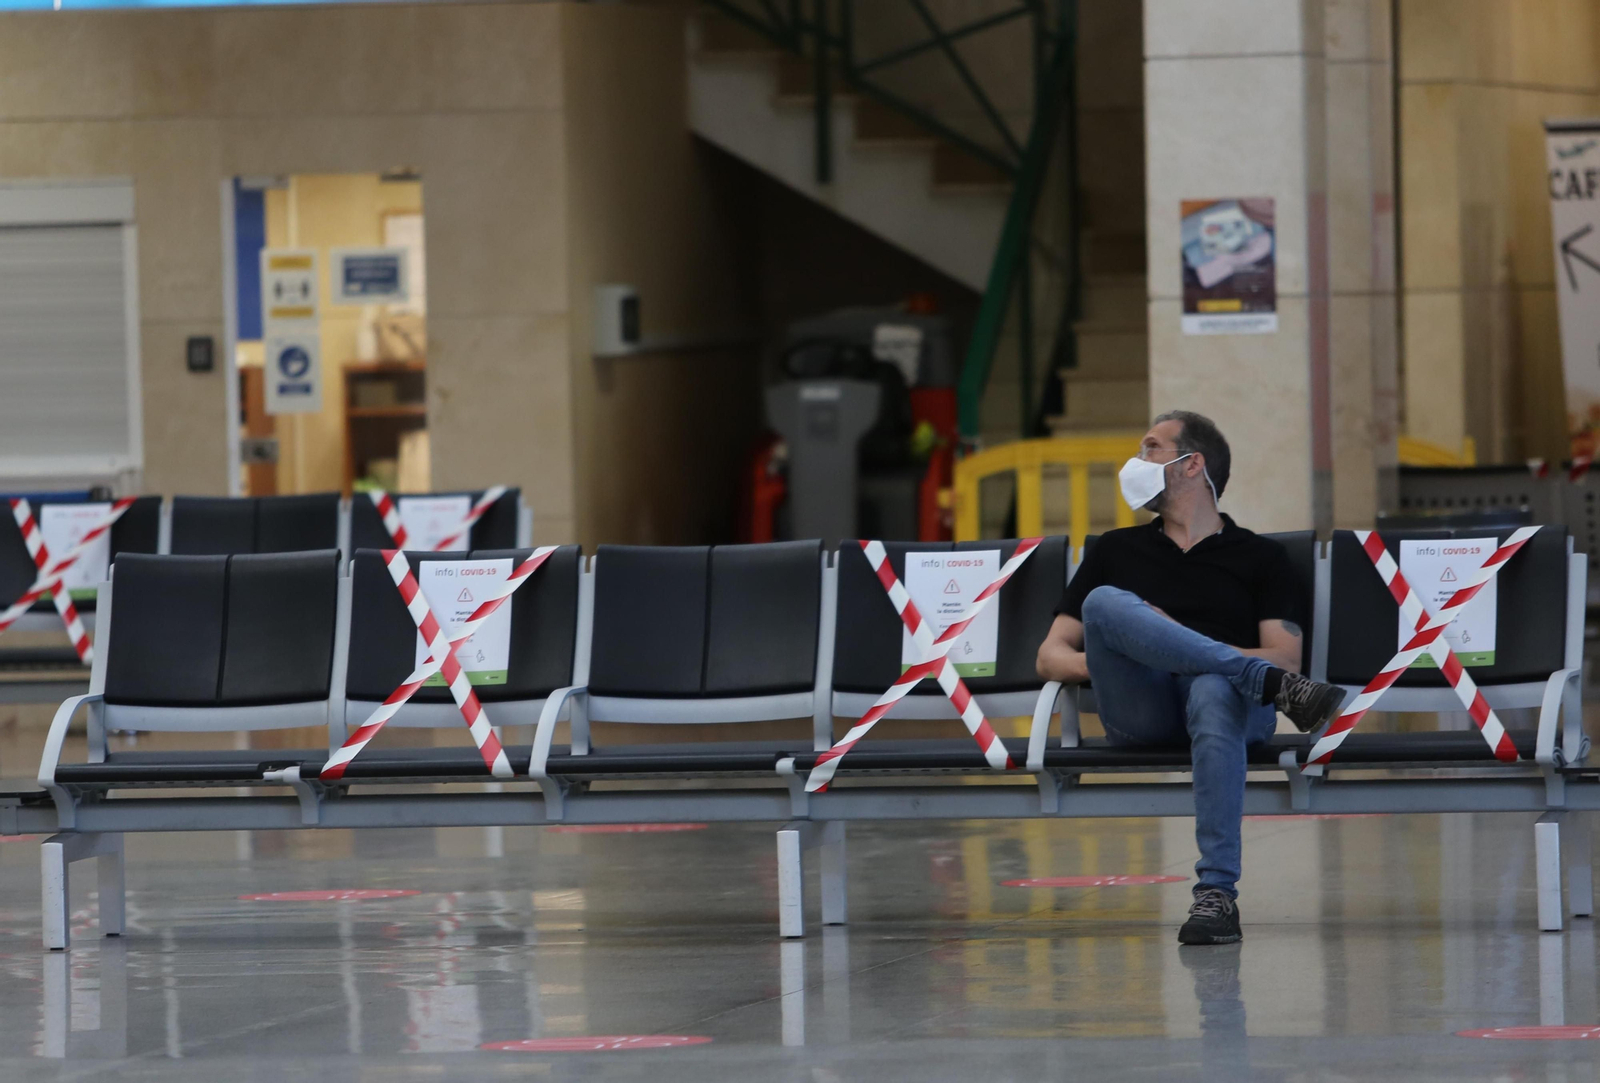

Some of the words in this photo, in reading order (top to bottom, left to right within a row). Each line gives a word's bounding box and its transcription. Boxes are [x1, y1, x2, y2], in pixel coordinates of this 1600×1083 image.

[1416, 546, 1436, 556] info
[1442, 547, 1481, 555] COVID-19
[921, 559, 940, 568] info
[946, 559, 984, 568] COVID-19
[435, 567, 454, 577] info
[460, 567, 497, 576] COVID-19
